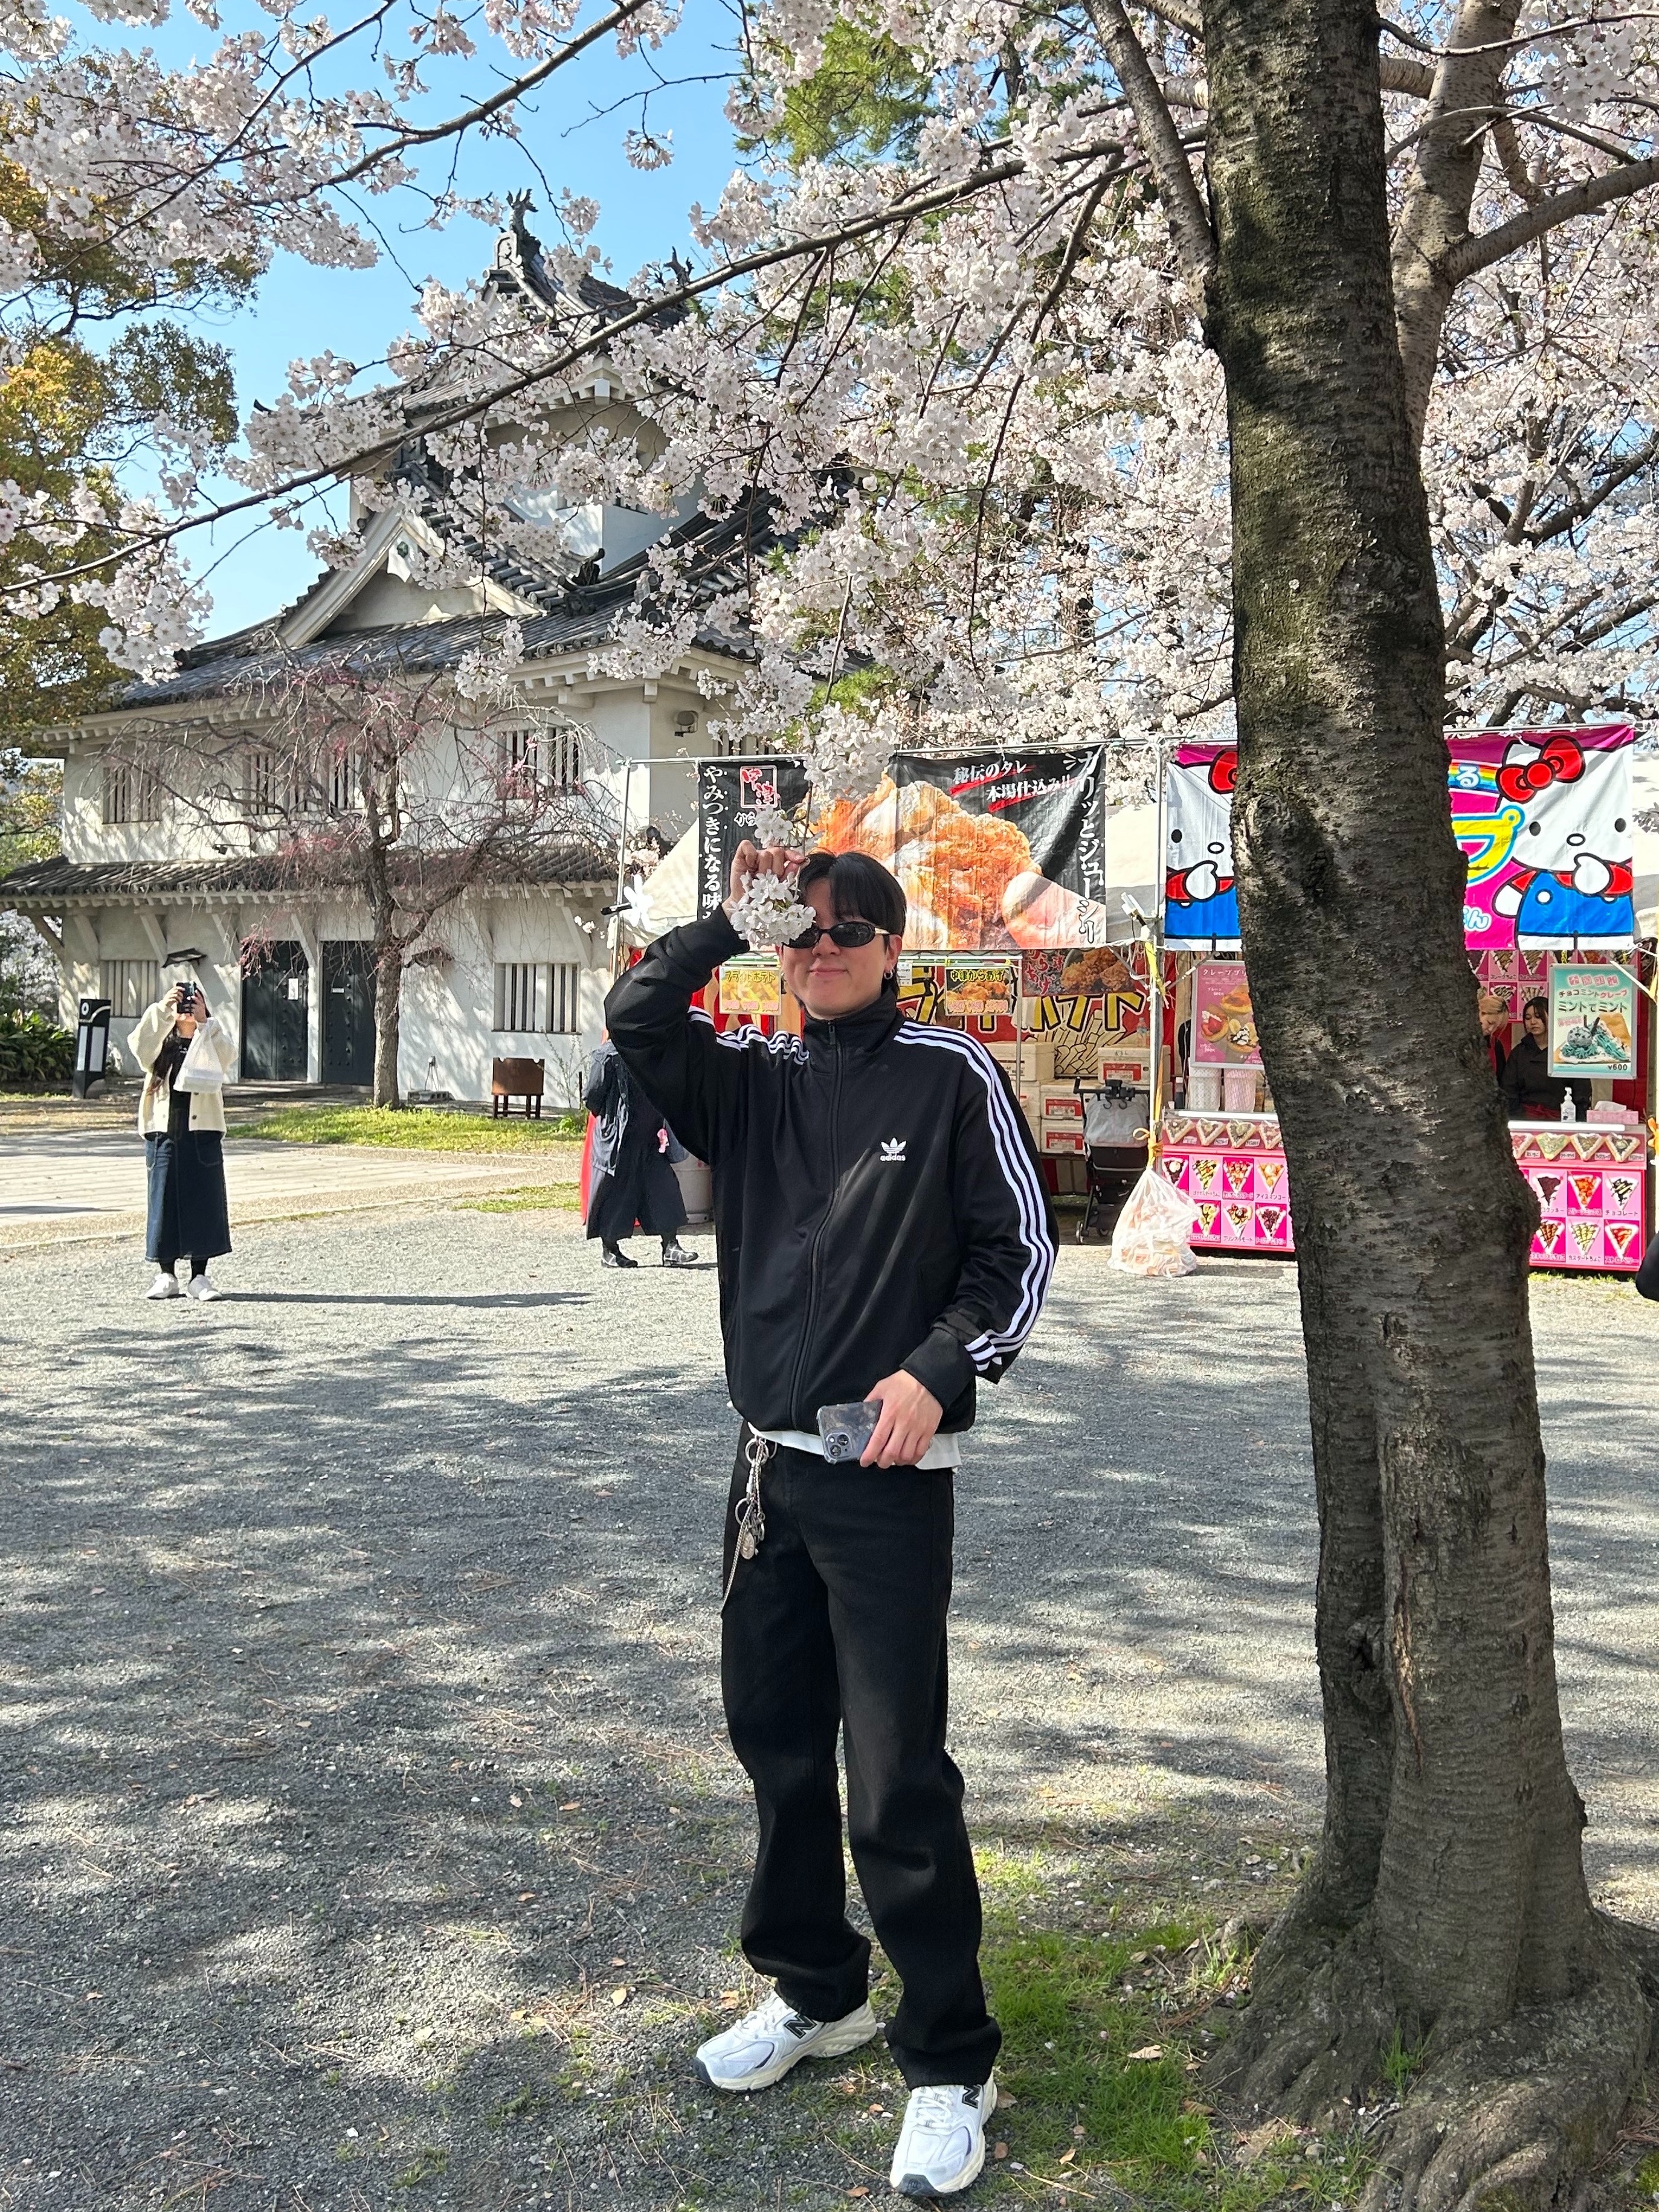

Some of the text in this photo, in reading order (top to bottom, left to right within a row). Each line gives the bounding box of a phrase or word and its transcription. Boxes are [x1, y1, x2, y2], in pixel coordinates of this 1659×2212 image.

[953, 759, 1027, 785] 秘伝のタレ
[1077, 751, 1104, 944] カリッとジューシー
[1559, 989, 1628, 998] チョコミントクレープ
